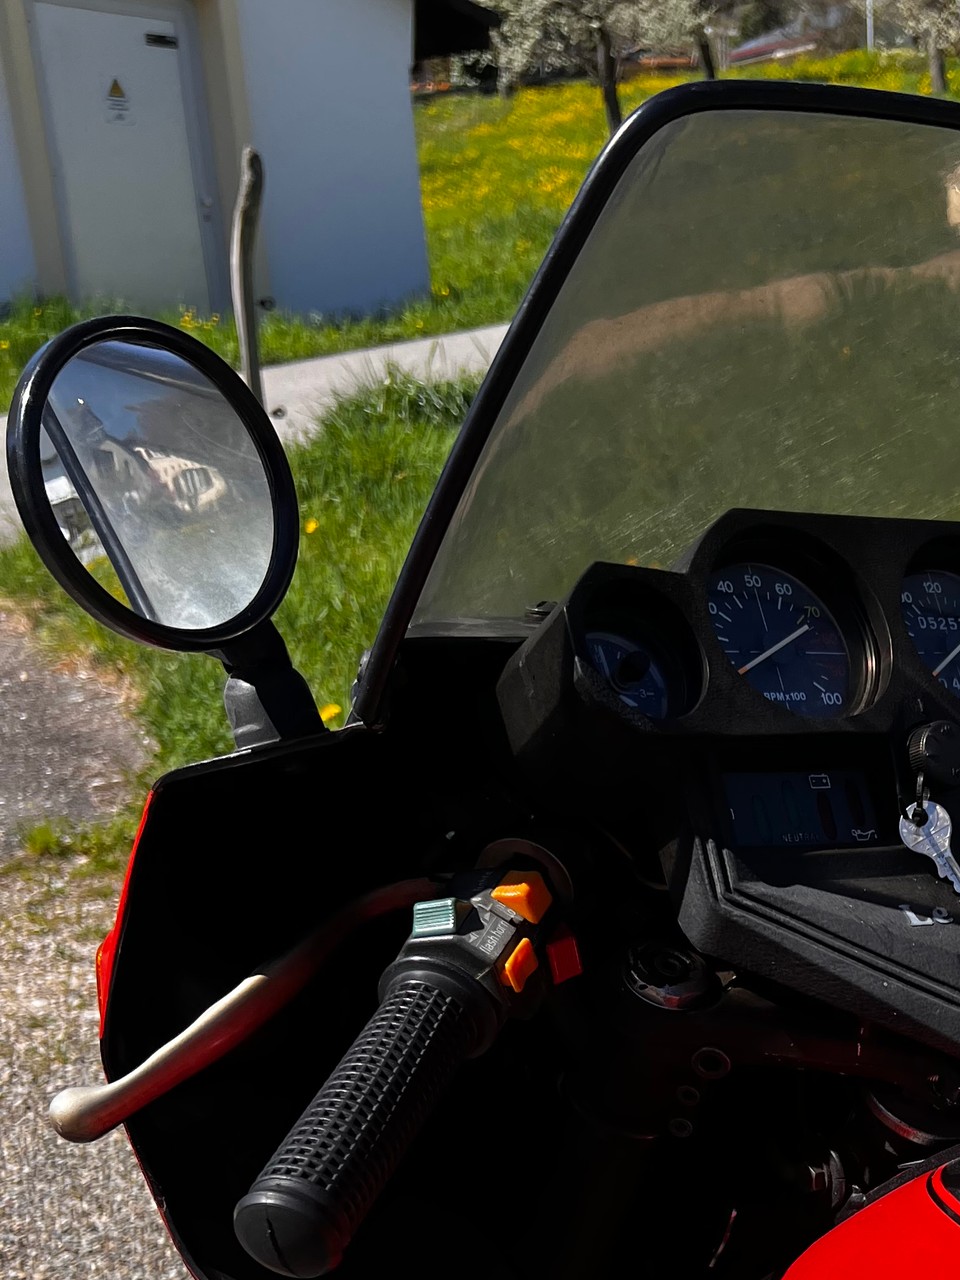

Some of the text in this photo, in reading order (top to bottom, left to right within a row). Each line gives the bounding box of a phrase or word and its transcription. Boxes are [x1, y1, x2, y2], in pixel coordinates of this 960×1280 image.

[717, 580, 734, 594] 40
[744, 575, 762, 588] 50
[923, 582, 942, 594] 120
[774, 583, 792, 596] 60
[803, 606, 821, 618] 70
[639, 688, 647, 698] 3
[821, 692, 843, 705] 100
